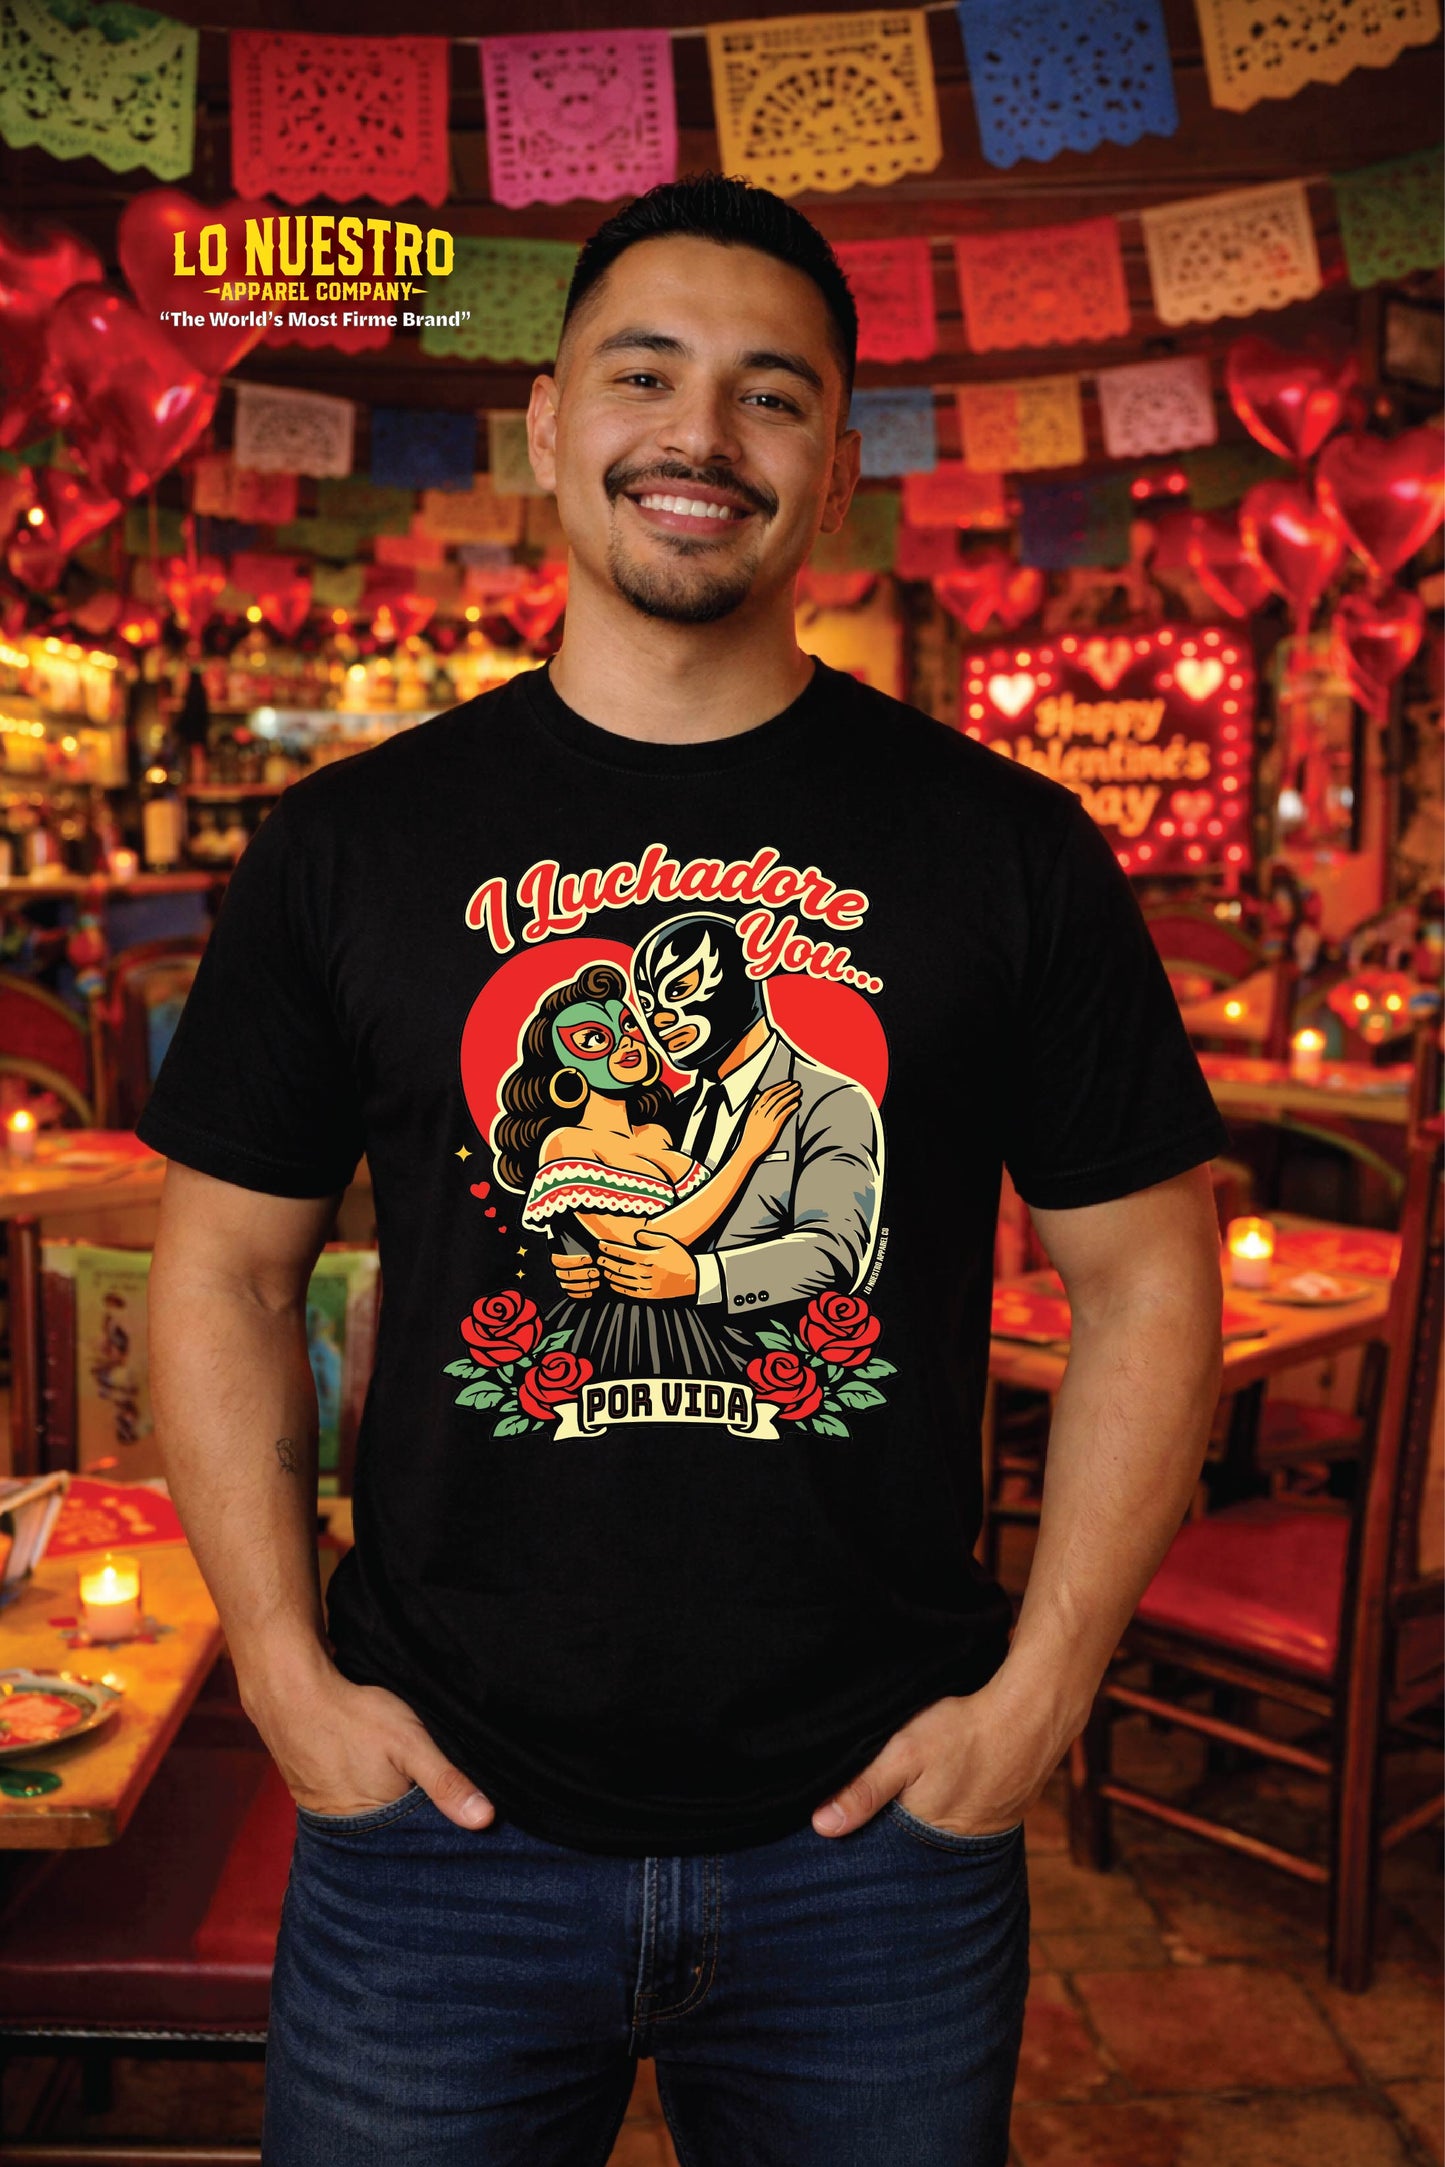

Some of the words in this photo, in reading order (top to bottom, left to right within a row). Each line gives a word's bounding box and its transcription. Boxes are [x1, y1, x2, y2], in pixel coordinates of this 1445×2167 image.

[1035, 691, 1166, 743] Happy
[465, 877, 515, 954] I
[516, 842, 870, 943] Luchadore
[735, 908, 884, 994] You...
[876, 1236, 889, 1262] APPAREL
[863, 1285, 873, 1295] LO
[867, 1261, 883, 1288] NUESTRO
[587, 1383, 652, 1423] POR
[661, 1382, 748, 1423] VIDA
